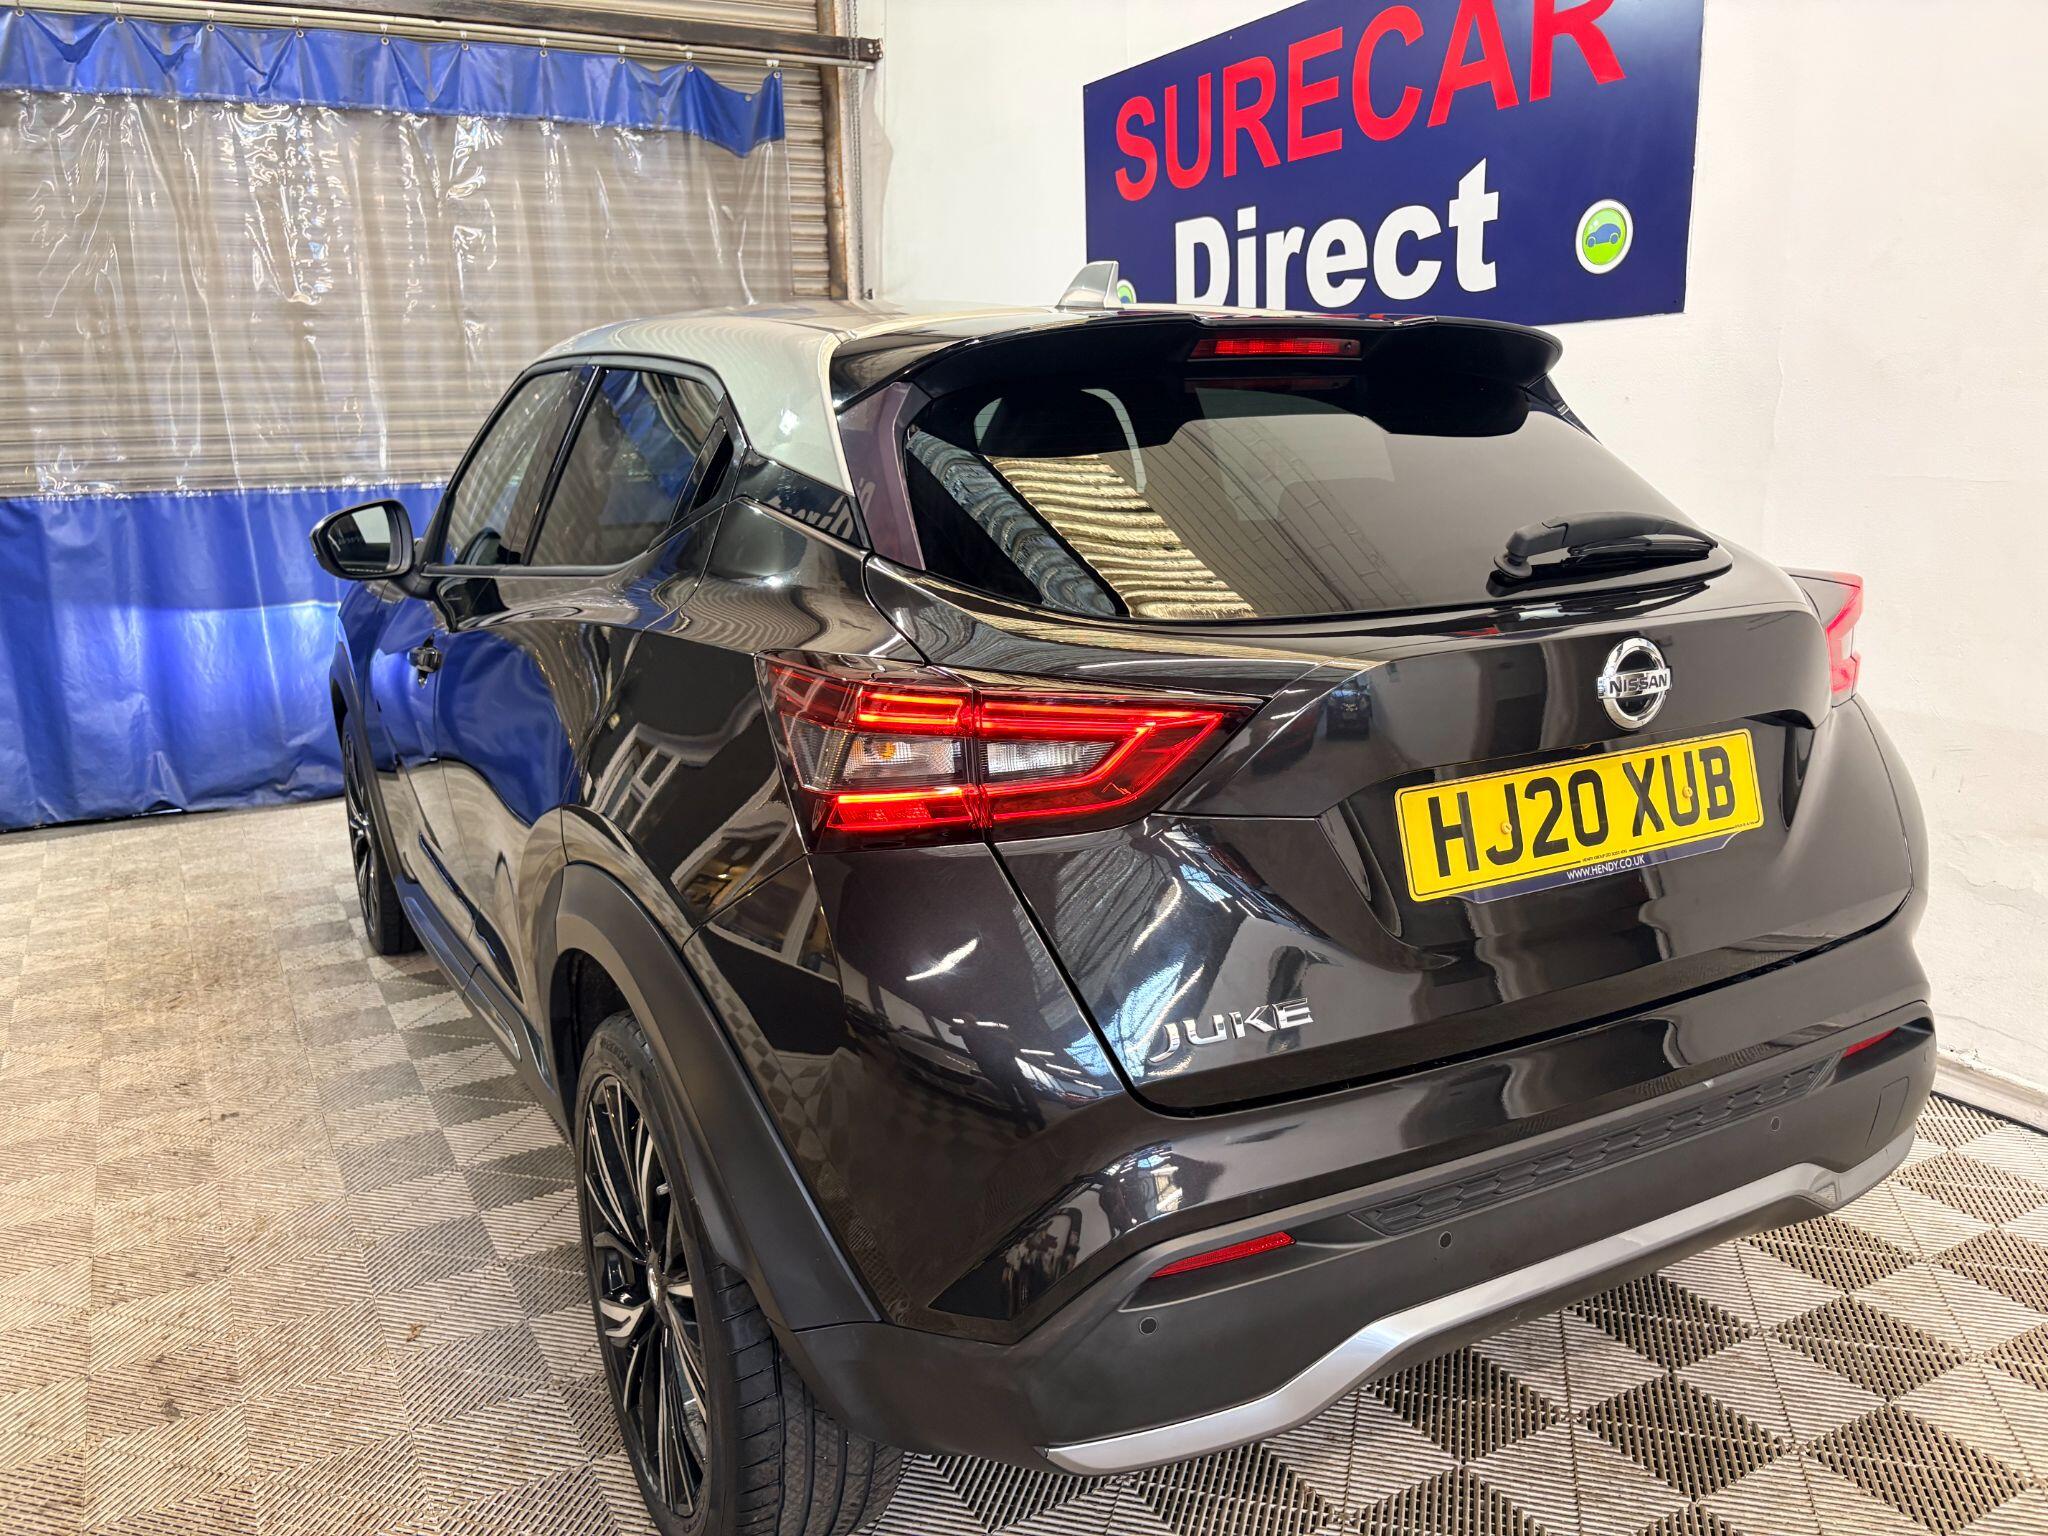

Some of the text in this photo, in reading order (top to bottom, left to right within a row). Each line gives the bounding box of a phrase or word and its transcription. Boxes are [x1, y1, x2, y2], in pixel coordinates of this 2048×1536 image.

[1114, 0, 1627, 202] SURECAR
[1175, 157, 1499, 309] Direct
[1609, 673, 1667, 694] NISSAN
[1427, 745, 1736, 878] HJ20 XUB
[1566, 855, 1645, 880] WWW.HENDY.CO.UK
[1149, 997, 1314, 1063] JUKE
